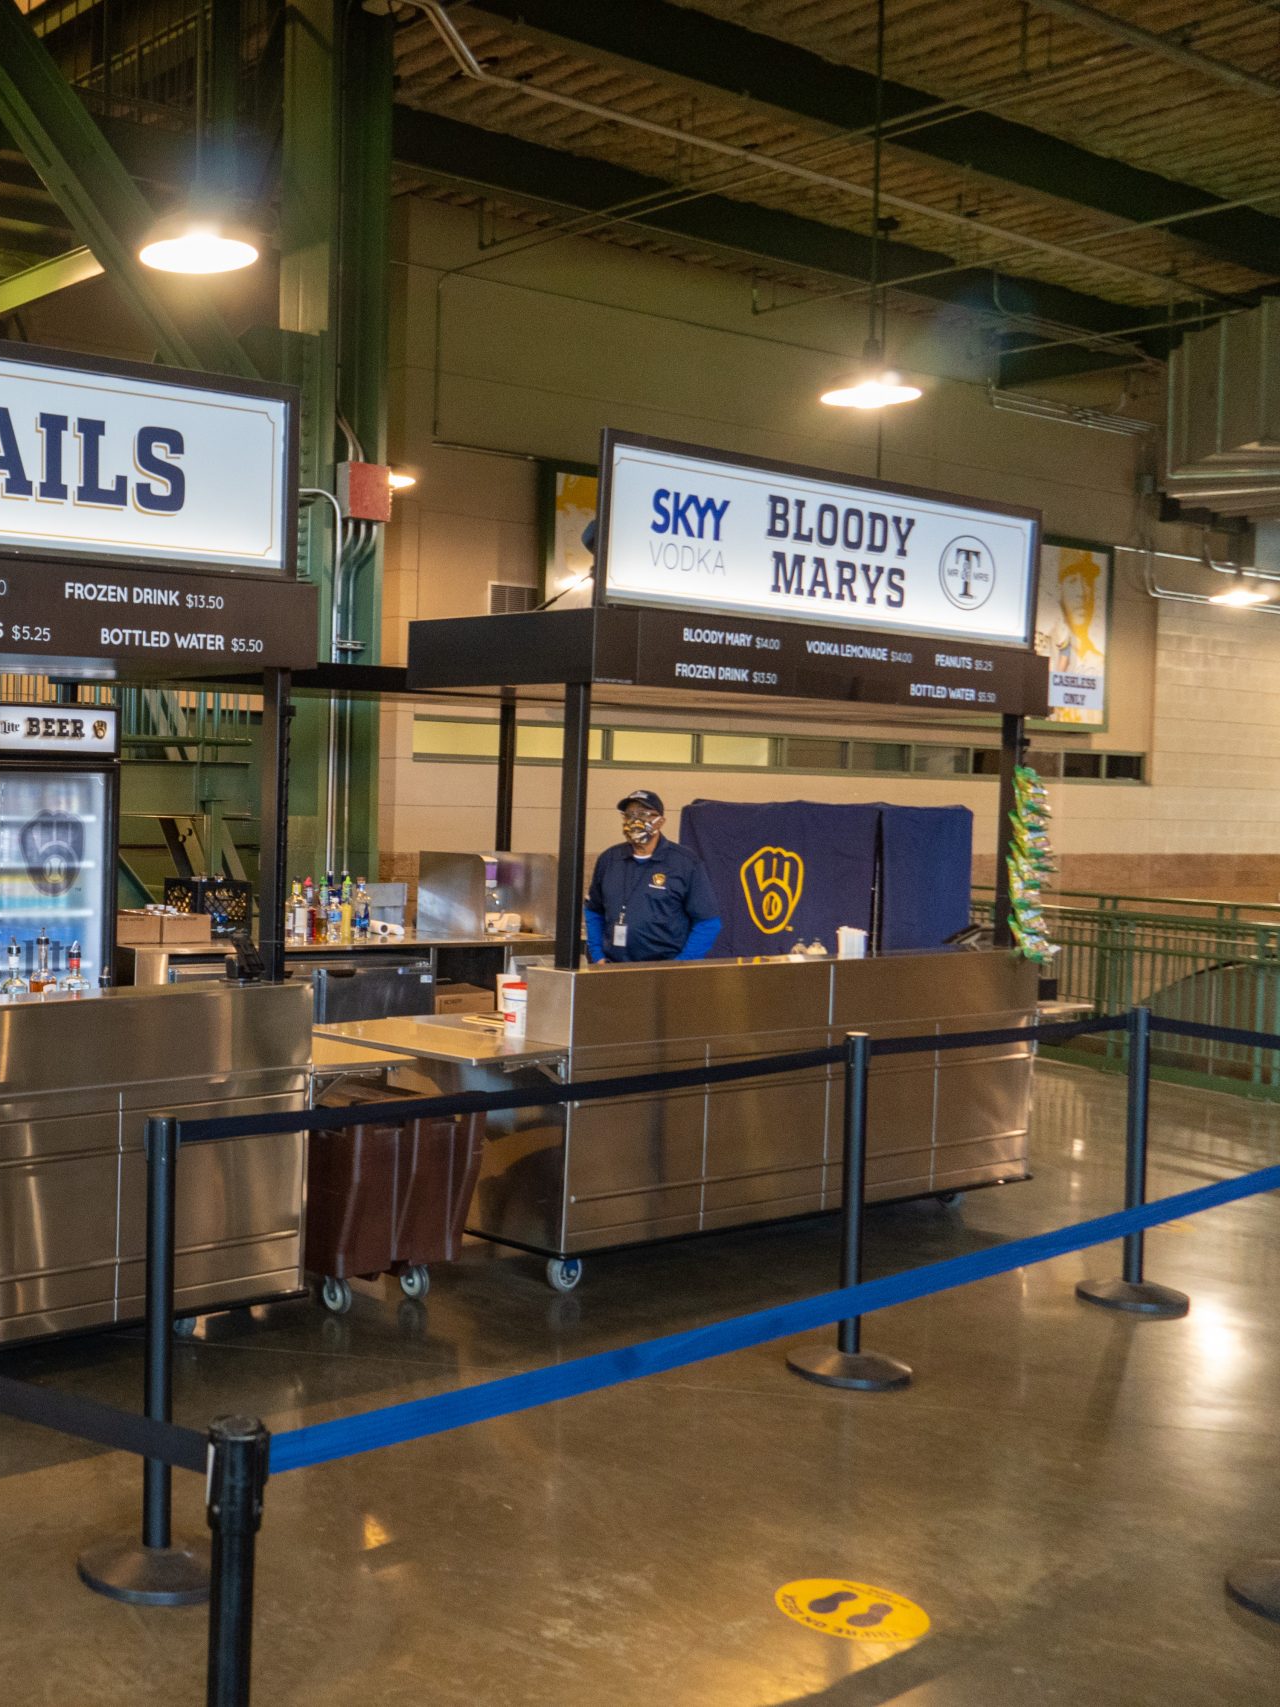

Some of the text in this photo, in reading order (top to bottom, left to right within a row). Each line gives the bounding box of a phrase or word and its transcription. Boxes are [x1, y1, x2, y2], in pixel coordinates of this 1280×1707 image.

[650, 488, 731, 541] SKYY
[766, 494, 915, 558] BLOODY
[649, 540, 727, 577] VODKA
[771, 551, 906, 609] MARYS
[65, 582, 224, 609] FROZEN DRINK $13.50
[12, 625, 50, 641] $5.25
[101, 628, 263, 652] BOTTLED WATER $5.50
[683, 628, 724, 644] BLOODY
[726, 632, 752, 646] MARY
[806, 641, 839, 655] VODKA
[841, 644, 888, 661] LEMONADE
[935, 654, 972, 669] PEANUTS
[675, 663, 716, 679] FROZEN
[718, 667, 749, 681] DRINK
[1052, 674, 1096, 690] CASHLESS
[910, 684, 947, 698] BOTTLED
[948, 688, 975, 700] WATER
[1063, 692, 1086, 706] ONLY
[1, 716, 85, 738] Lite BEER
